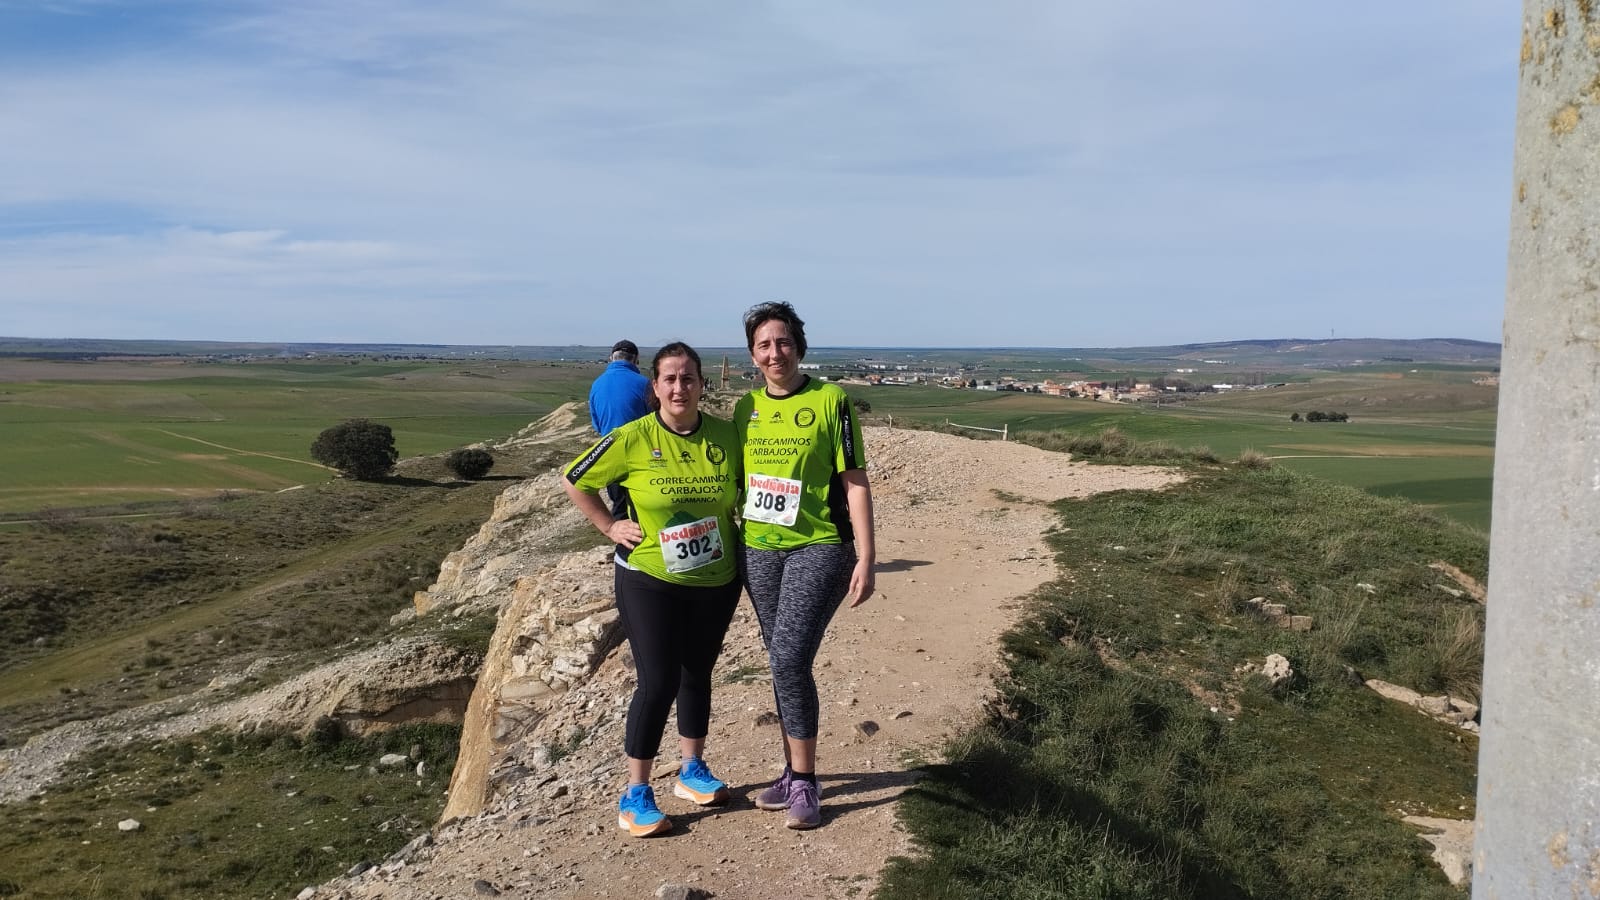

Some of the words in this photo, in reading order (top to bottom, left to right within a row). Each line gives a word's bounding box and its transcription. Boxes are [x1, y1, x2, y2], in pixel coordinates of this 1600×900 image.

[750, 448, 798, 456] CARBAJOSA
[649, 474, 730, 485] CORRECAMINOS
[660, 485, 724, 495] CARBAJOSA
[754, 491, 786, 512] 308
[676, 535, 712, 560] 302
